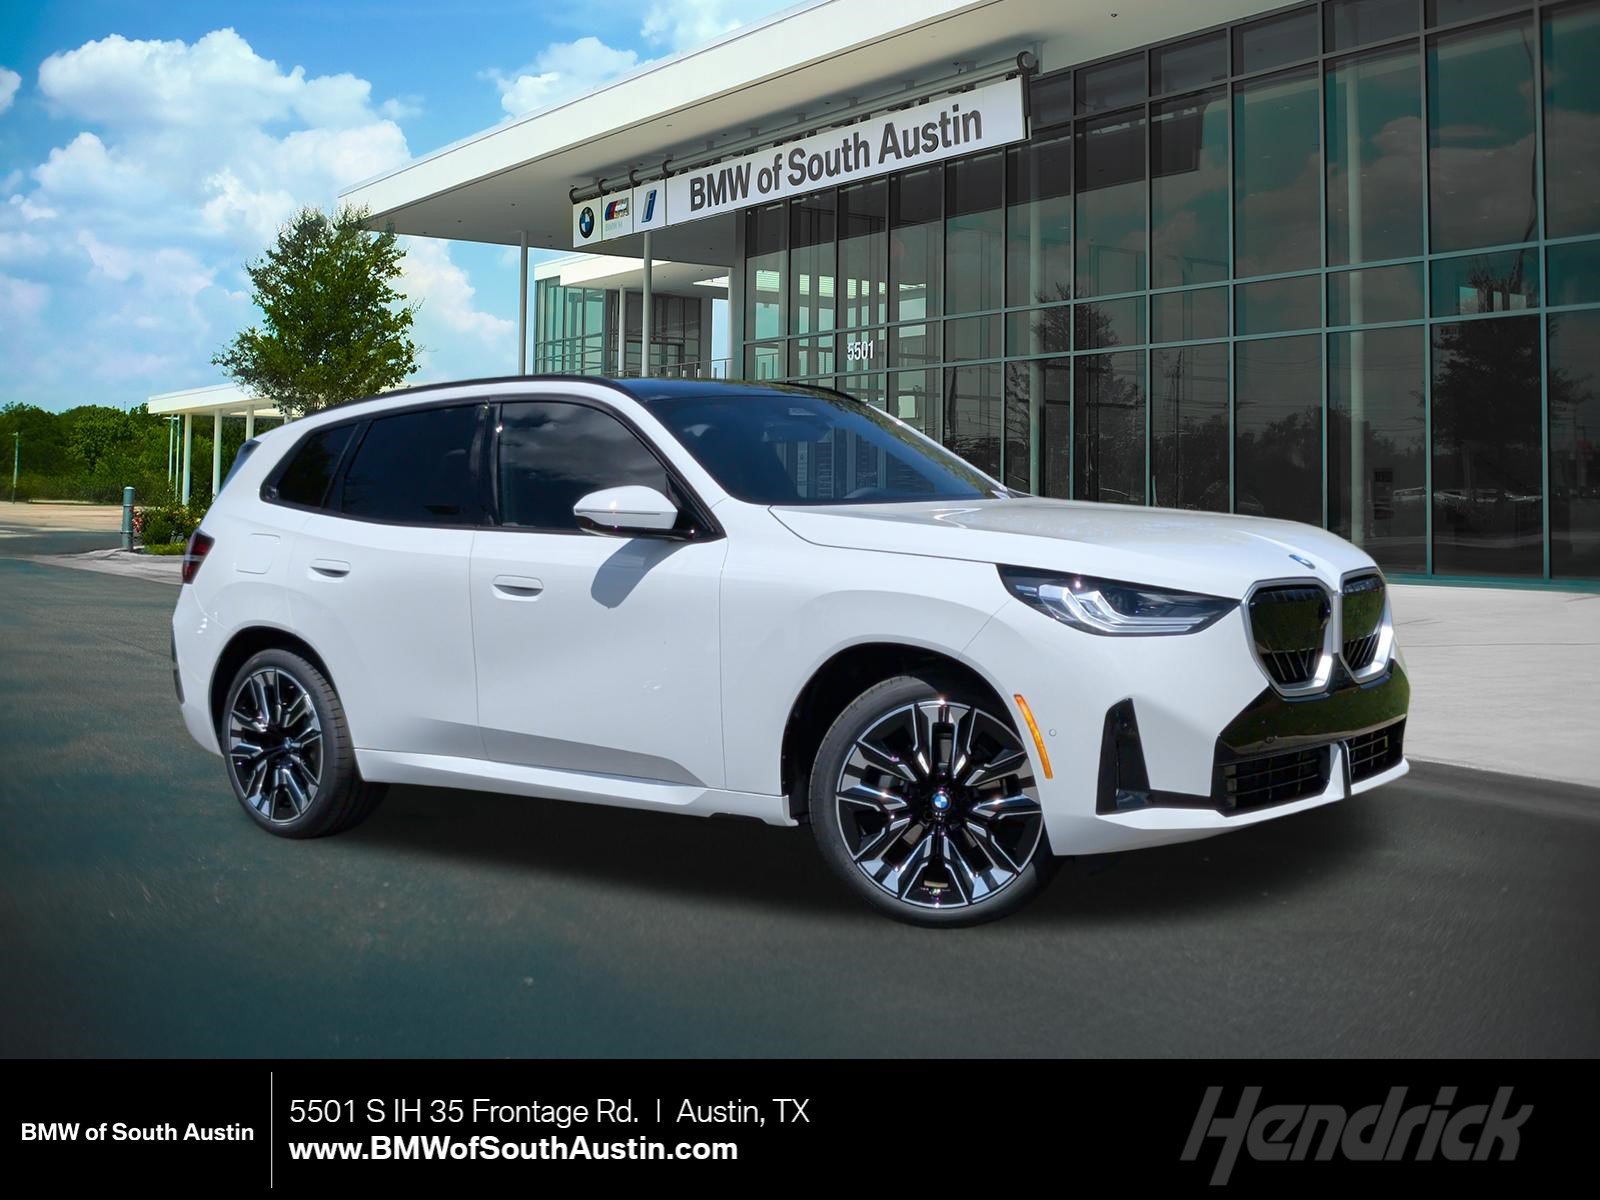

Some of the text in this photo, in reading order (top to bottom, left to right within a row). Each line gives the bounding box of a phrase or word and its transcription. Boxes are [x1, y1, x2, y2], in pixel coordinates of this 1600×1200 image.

[690, 162, 751, 211] BMW
[757, 153, 782, 194] of
[787, 132, 870, 186] South
[878, 104, 982, 164] Austin
[847, 340, 873, 361] 5501
